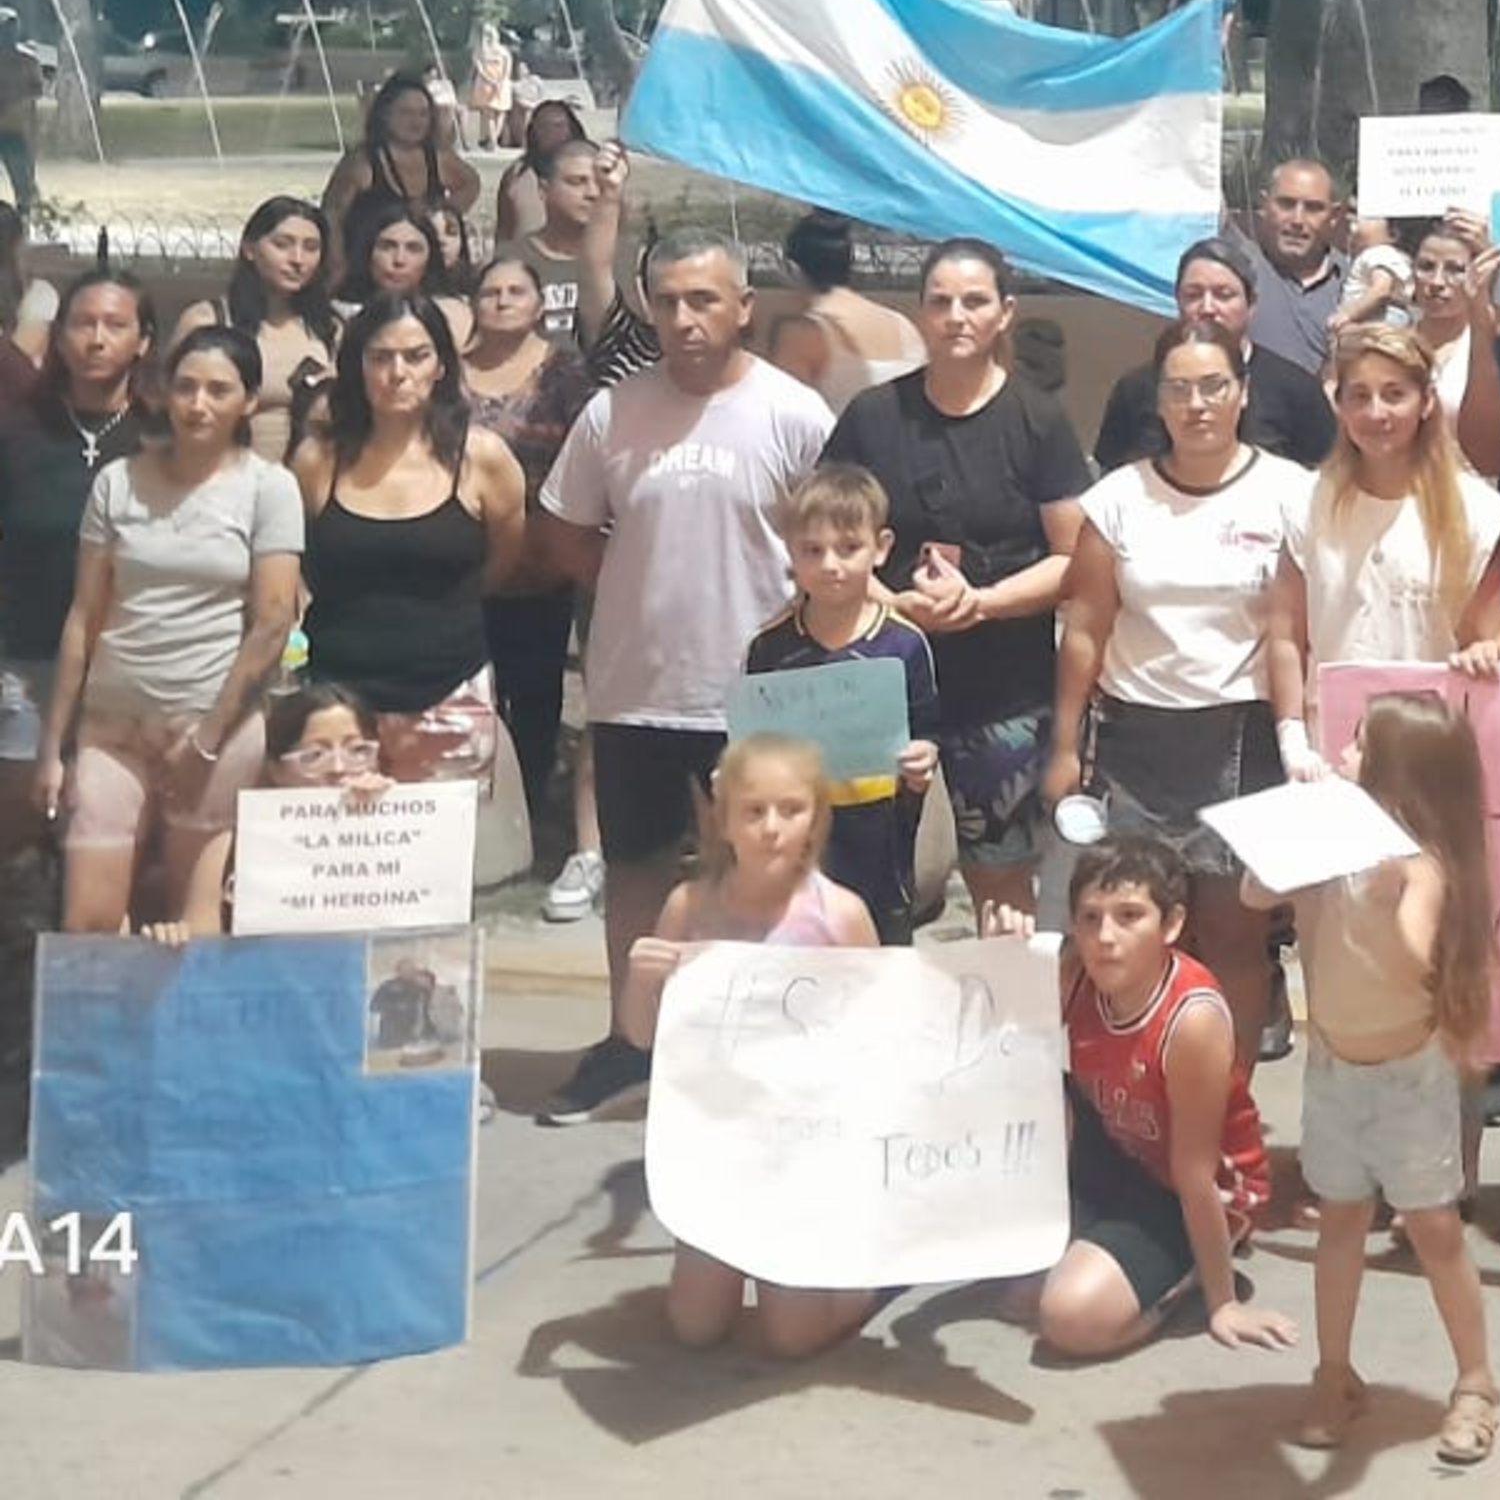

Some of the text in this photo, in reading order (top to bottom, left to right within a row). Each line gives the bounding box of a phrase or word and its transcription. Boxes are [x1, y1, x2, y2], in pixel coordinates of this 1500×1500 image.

[280, 800, 436, 820] PARA MUCHOS
[312, 862, 369, 878] PARA
